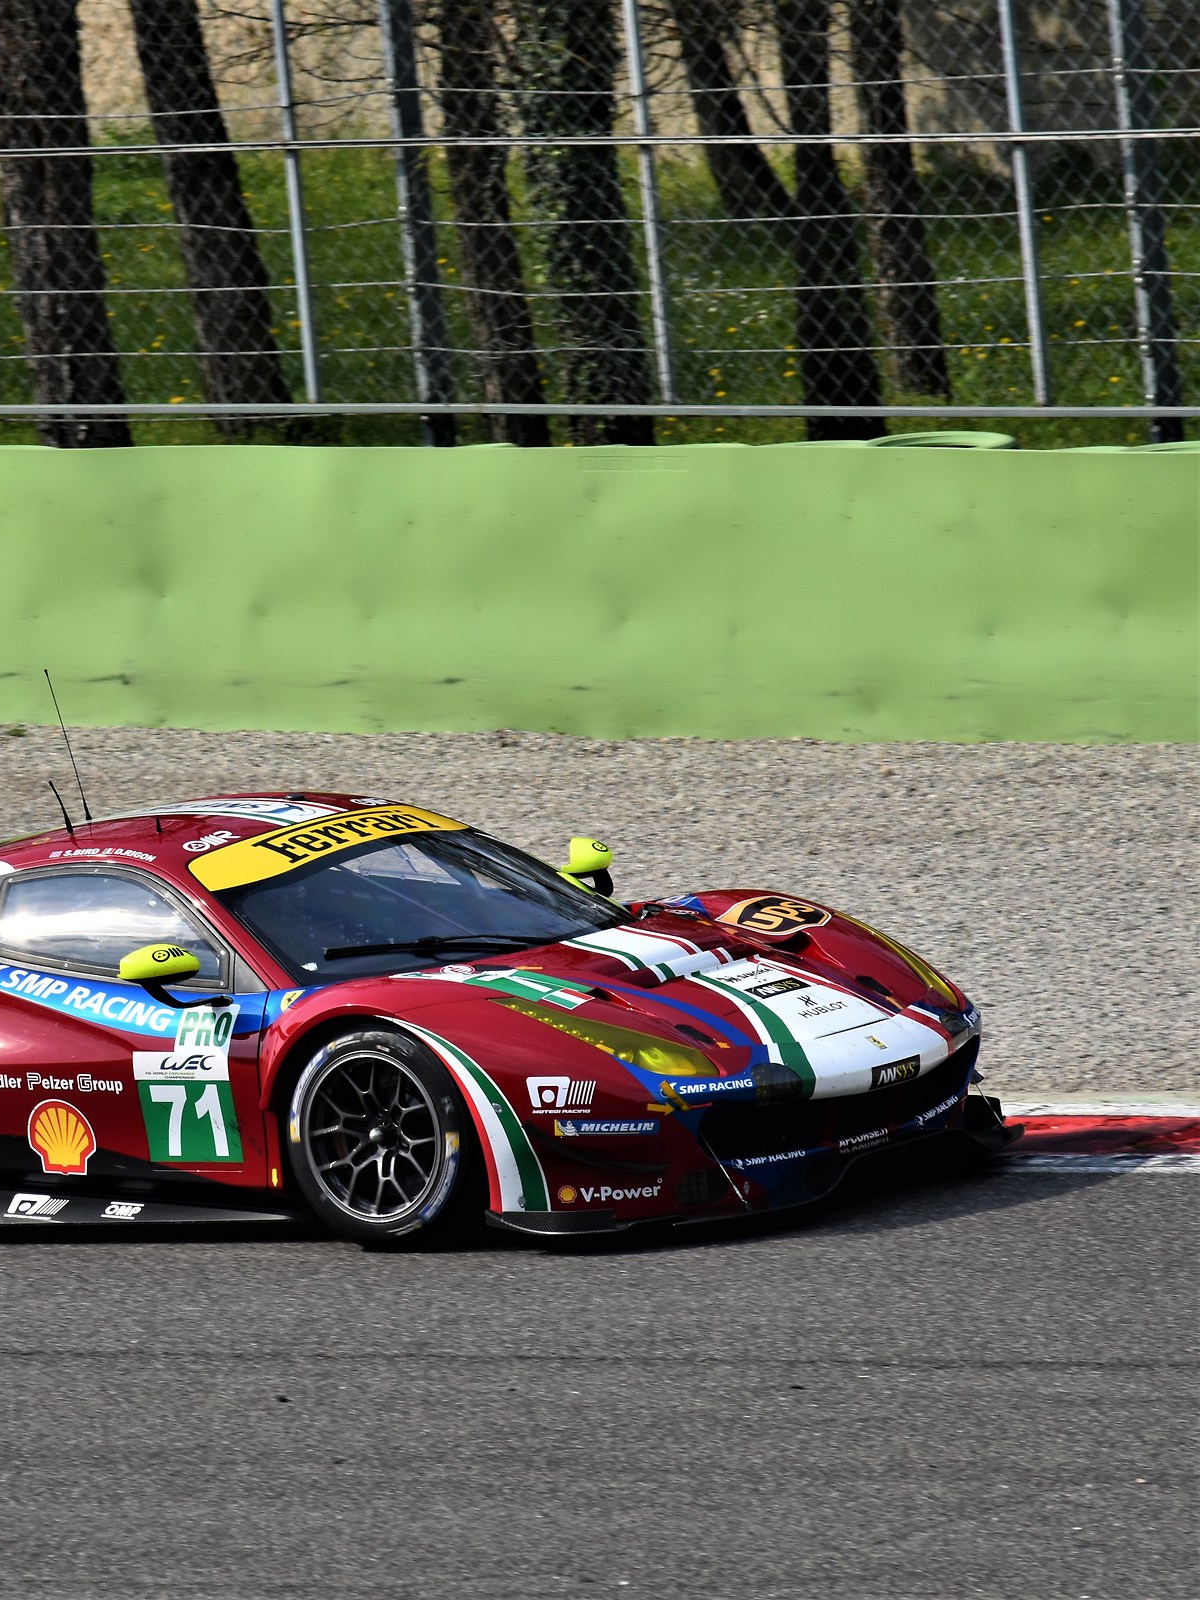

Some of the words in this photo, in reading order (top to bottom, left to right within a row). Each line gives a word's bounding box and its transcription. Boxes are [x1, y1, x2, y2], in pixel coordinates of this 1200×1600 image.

[251, 809, 440, 864] Ferrari
[741, 902, 816, 930] ups
[0, 969, 69, 999] SMP
[62, 985, 177, 1031] RACING
[798, 1001, 848, 1018] HUBLOT
[179, 1011, 233, 1047] PRO
[160, 1055, 216, 1071] WEC
[877, 1061, 915, 1085] ANSYS
[26, 1072, 74, 1090] Pelzer
[77, 1073, 123, 1094] Group
[679, 1084, 708, 1094] SMP
[709, 1079, 753, 1092] RACING
[149, 1084, 230, 1157] 71
[580, 1122, 655, 1132] MICHELIN
[580, 1186, 661, 1203] V-Power
[105, 1204, 142, 1217] OMP
